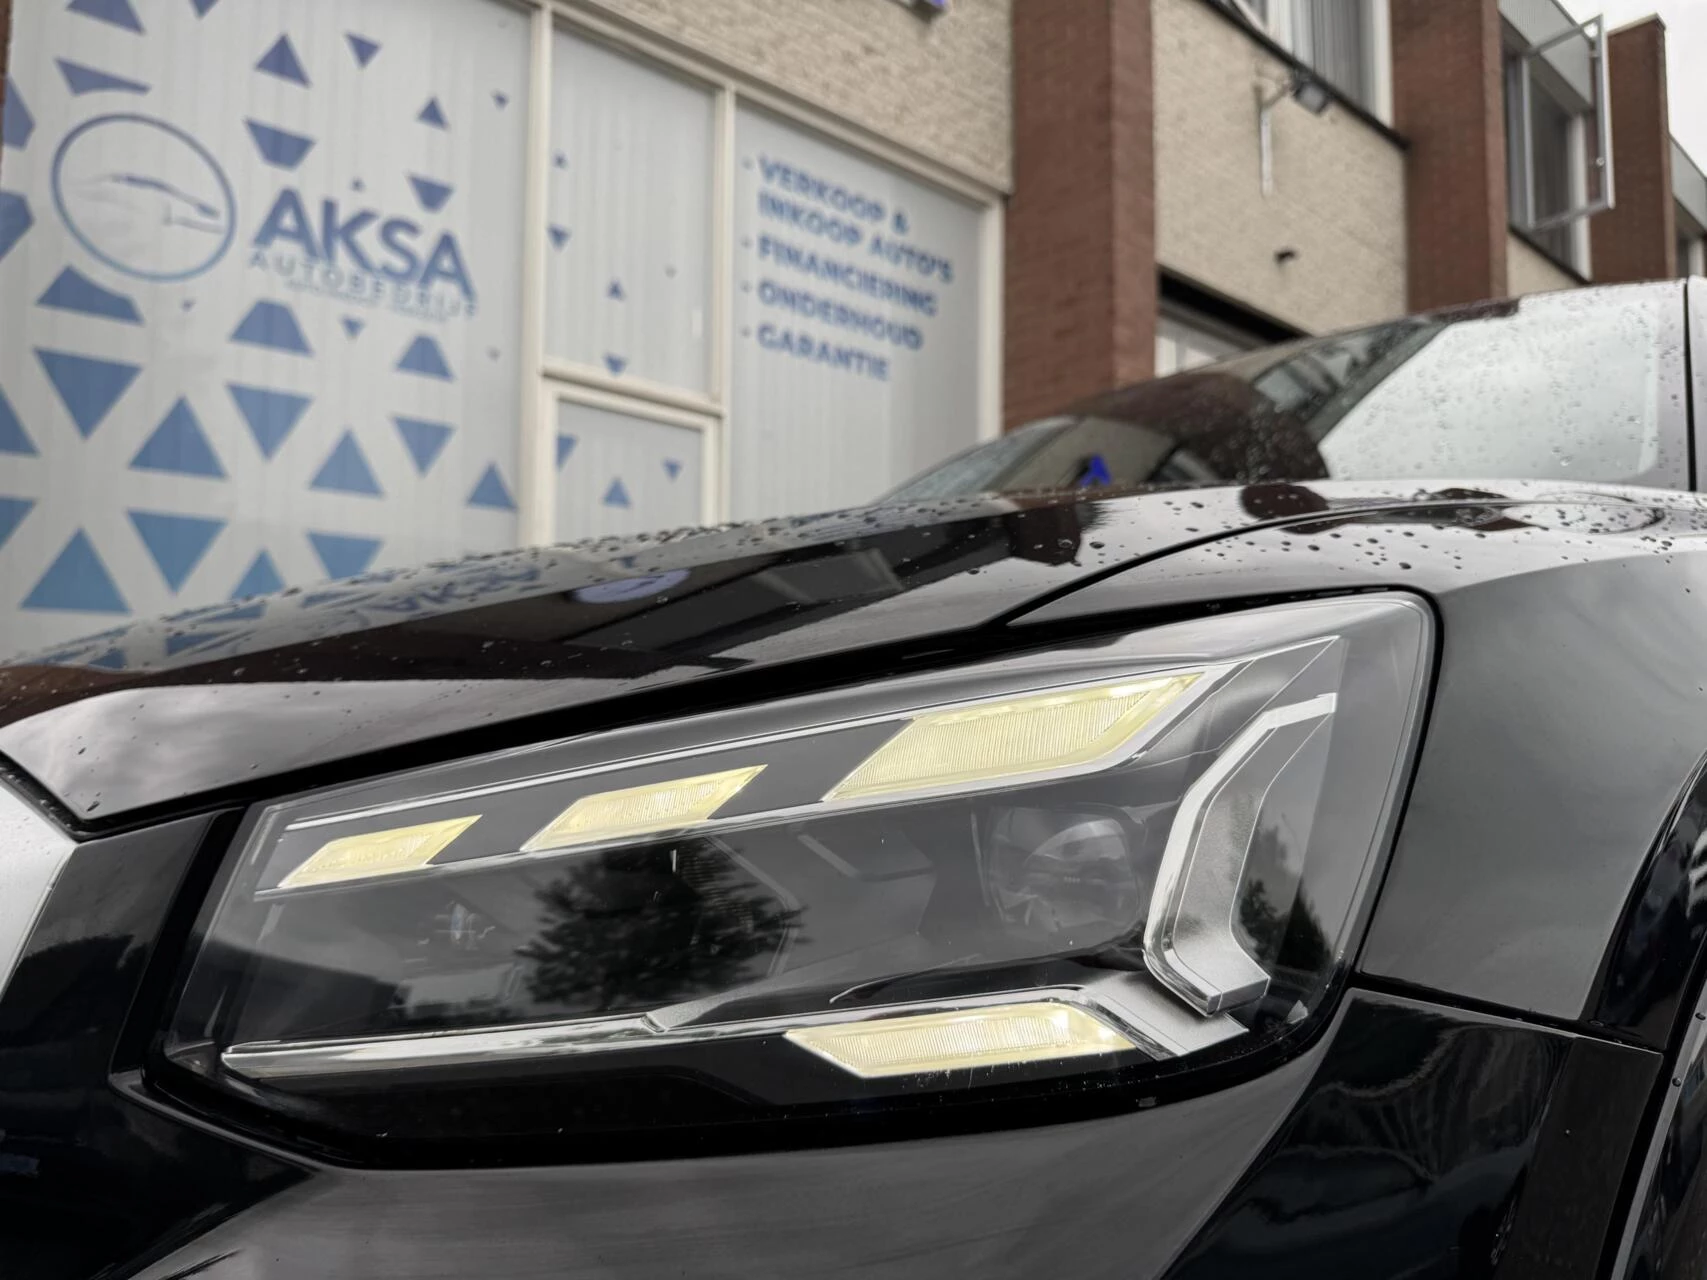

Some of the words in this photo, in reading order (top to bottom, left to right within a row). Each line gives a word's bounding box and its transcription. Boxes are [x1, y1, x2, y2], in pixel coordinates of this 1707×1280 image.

[759, 157, 886, 223] VERKOOP
[892, 209, 908, 235] &
[253, 187, 478, 302] AKSA
[759, 190, 862, 246] INKOOP
[870, 235, 954, 284] AUTO'S
[759, 233, 937, 318] FINANCIERING
[757, 279, 924, 351] ONDERHOUD
[757, 323, 888, 381] GARANTIE
